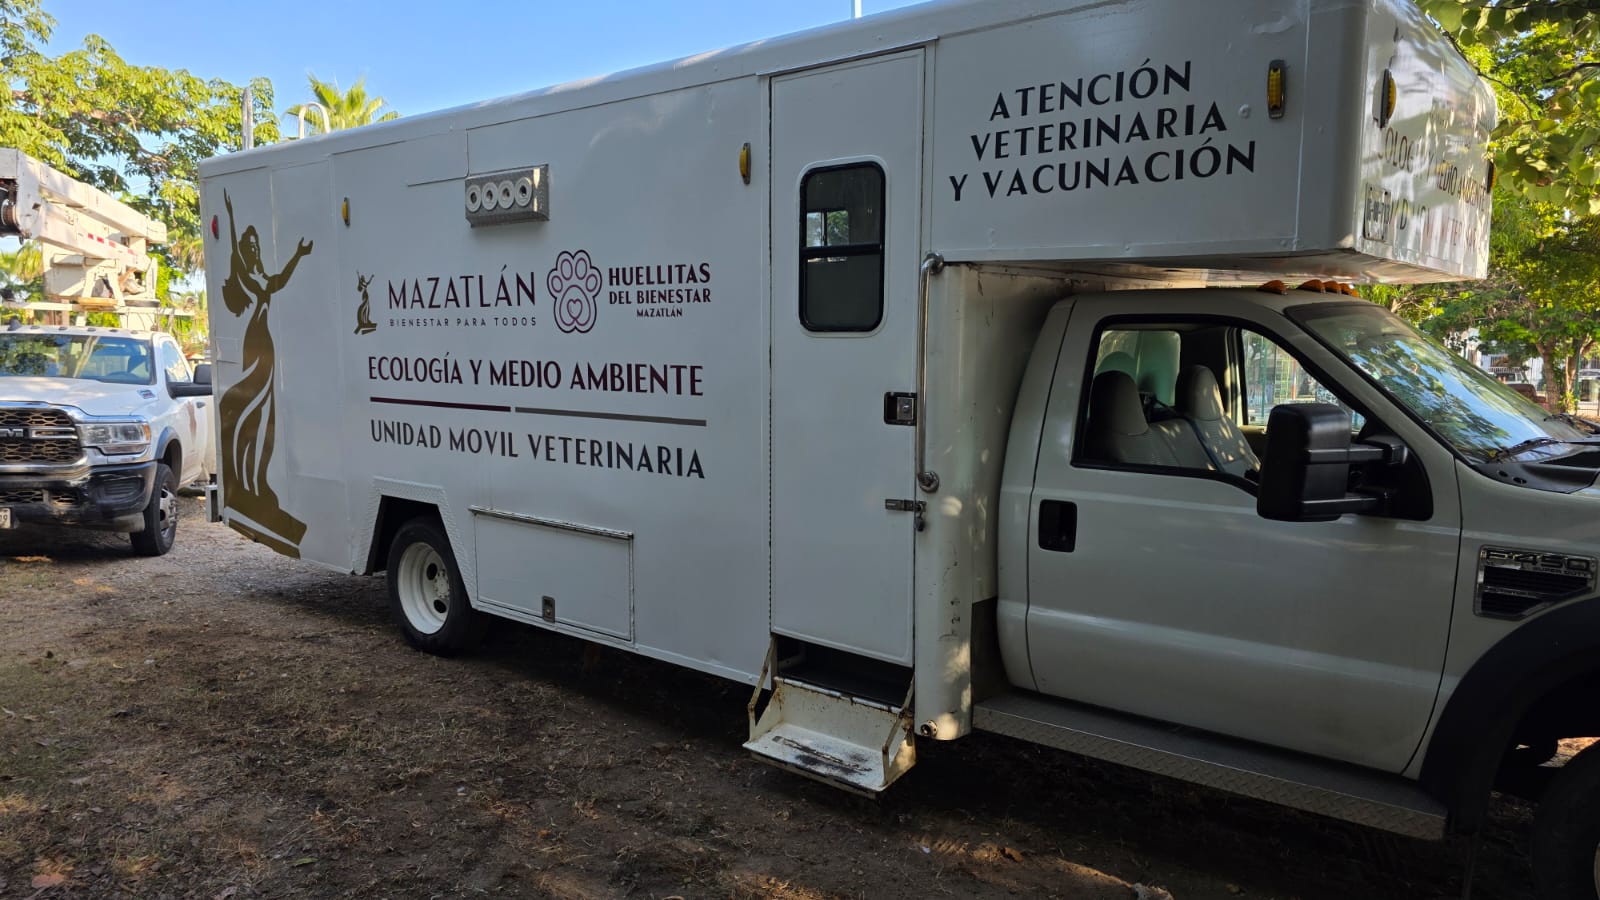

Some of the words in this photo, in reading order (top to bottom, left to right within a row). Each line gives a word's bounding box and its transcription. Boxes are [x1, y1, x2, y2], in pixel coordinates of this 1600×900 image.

[989, 58, 1191, 121] ATENCIÓN
[971, 102, 1227, 161] VETERINARIA
[949, 174, 967, 201] Y
[983, 137, 1255, 198] VACUNACIÓN
[388, 264, 535, 309] MAZATLÁN
[609, 262, 711, 286] HUELLITAS
[609, 292, 632, 304] DEL
[637, 289, 711, 304] BIENESTAR
[637, 306, 683, 317] MAZATLÁN
[389, 318, 449, 327] BIENESTAR
[456, 318, 486, 327] PARA
[494, 317, 537, 327] TODOS
[368, 352, 462, 384] ECOLOGÍA
[469, 359, 483, 385] Y
[489, 360, 561, 388] MEDIO
[570, 362, 703, 396] AMBIENTE
[371, 420, 441, 448] UNIDAD
[449, 427, 518, 458] MOVIL
[528, 434, 705, 479] VETERINARIA
